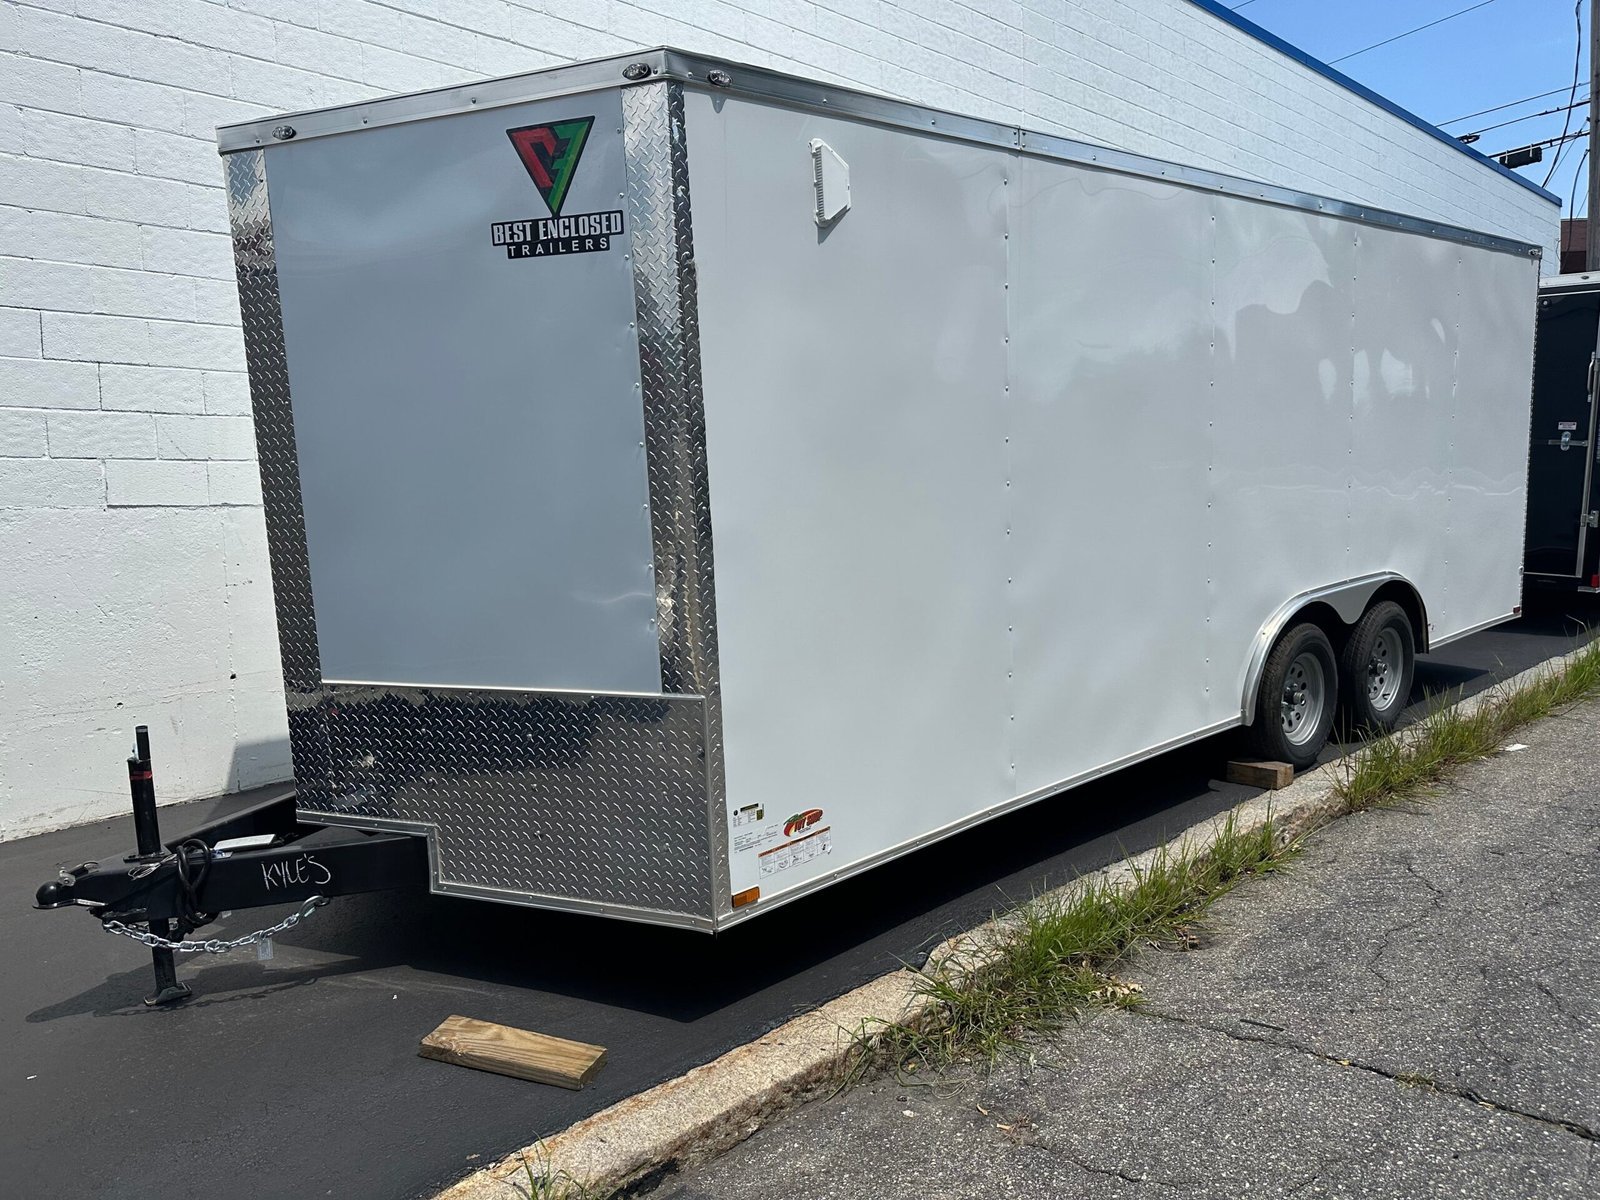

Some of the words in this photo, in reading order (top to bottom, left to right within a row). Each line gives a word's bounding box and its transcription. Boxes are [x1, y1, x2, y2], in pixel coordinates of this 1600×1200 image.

[492, 221, 532, 244] BEST
[538, 212, 622, 241] ENCLOSED
[508, 237, 608, 257] TRAILERS
[261, 852, 331, 891] KYLE'S
